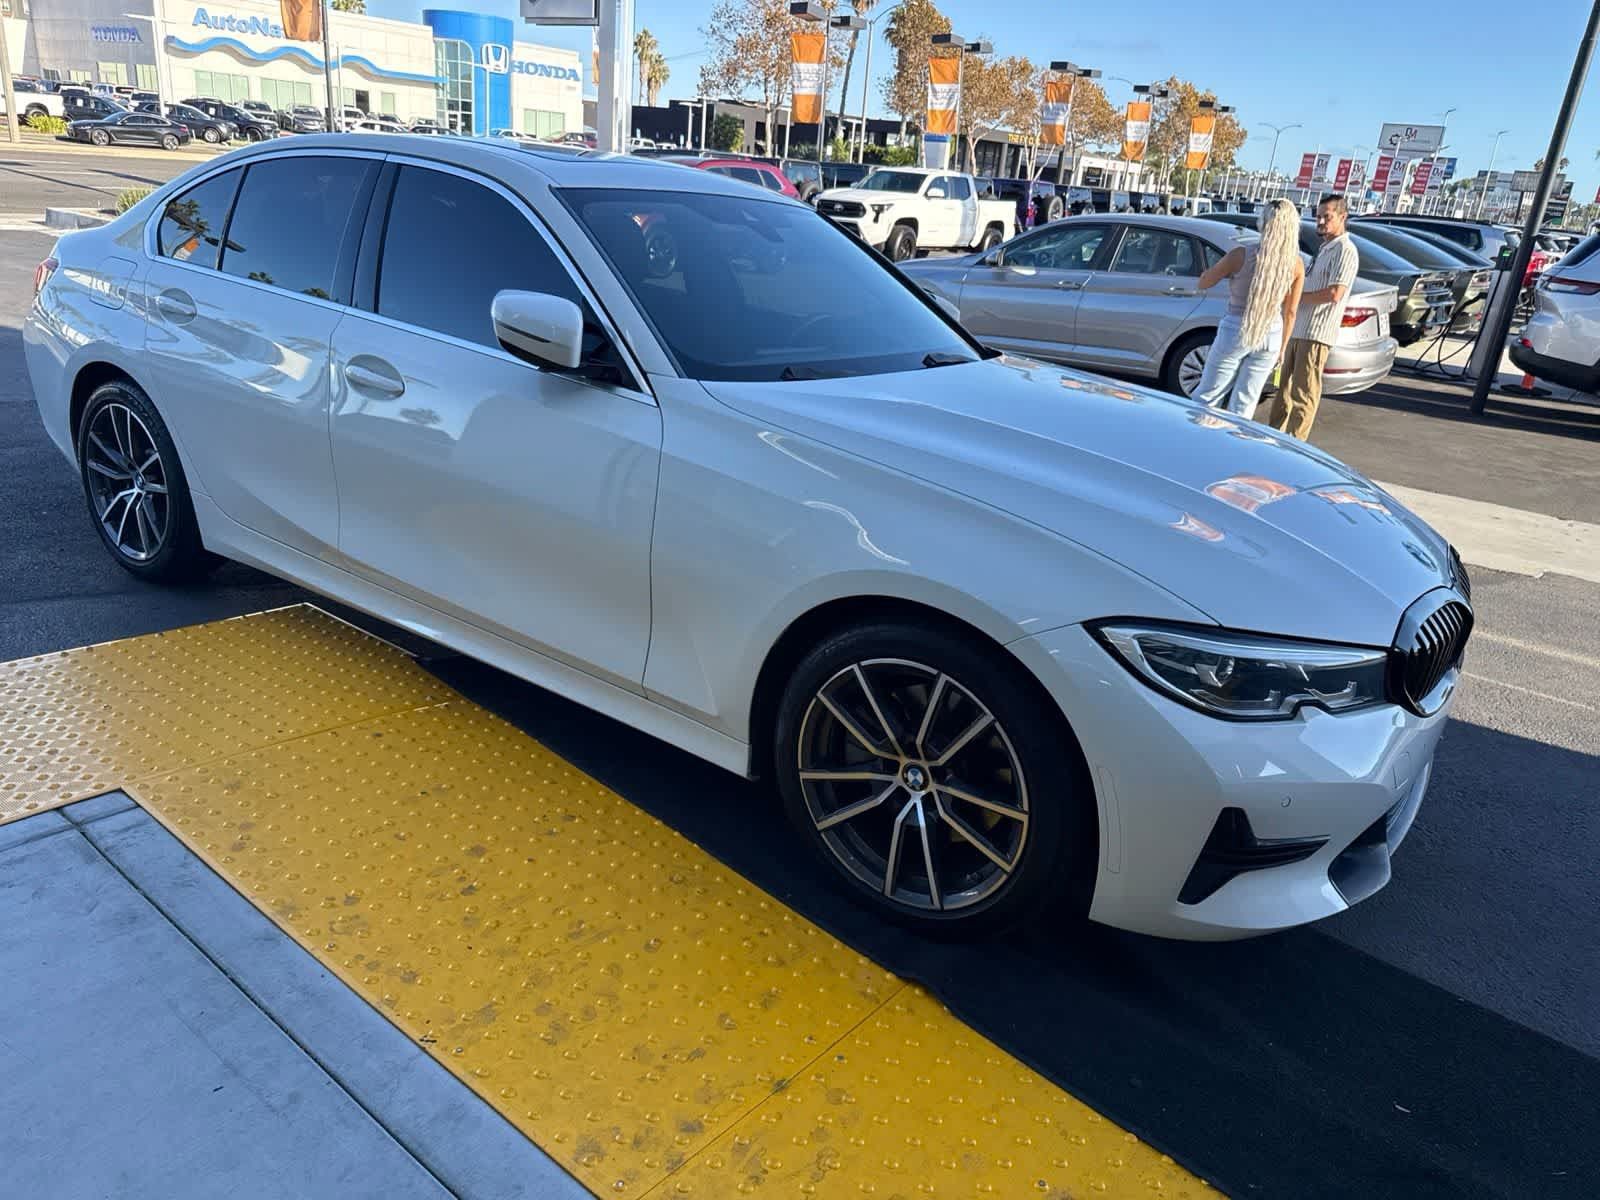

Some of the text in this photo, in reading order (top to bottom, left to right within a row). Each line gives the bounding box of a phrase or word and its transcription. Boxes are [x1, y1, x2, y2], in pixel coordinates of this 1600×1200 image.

[192, 7, 283, 38] AutoNa
[91, 26, 143, 43] HONDA
[510, 61, 580, 81] HONDA
